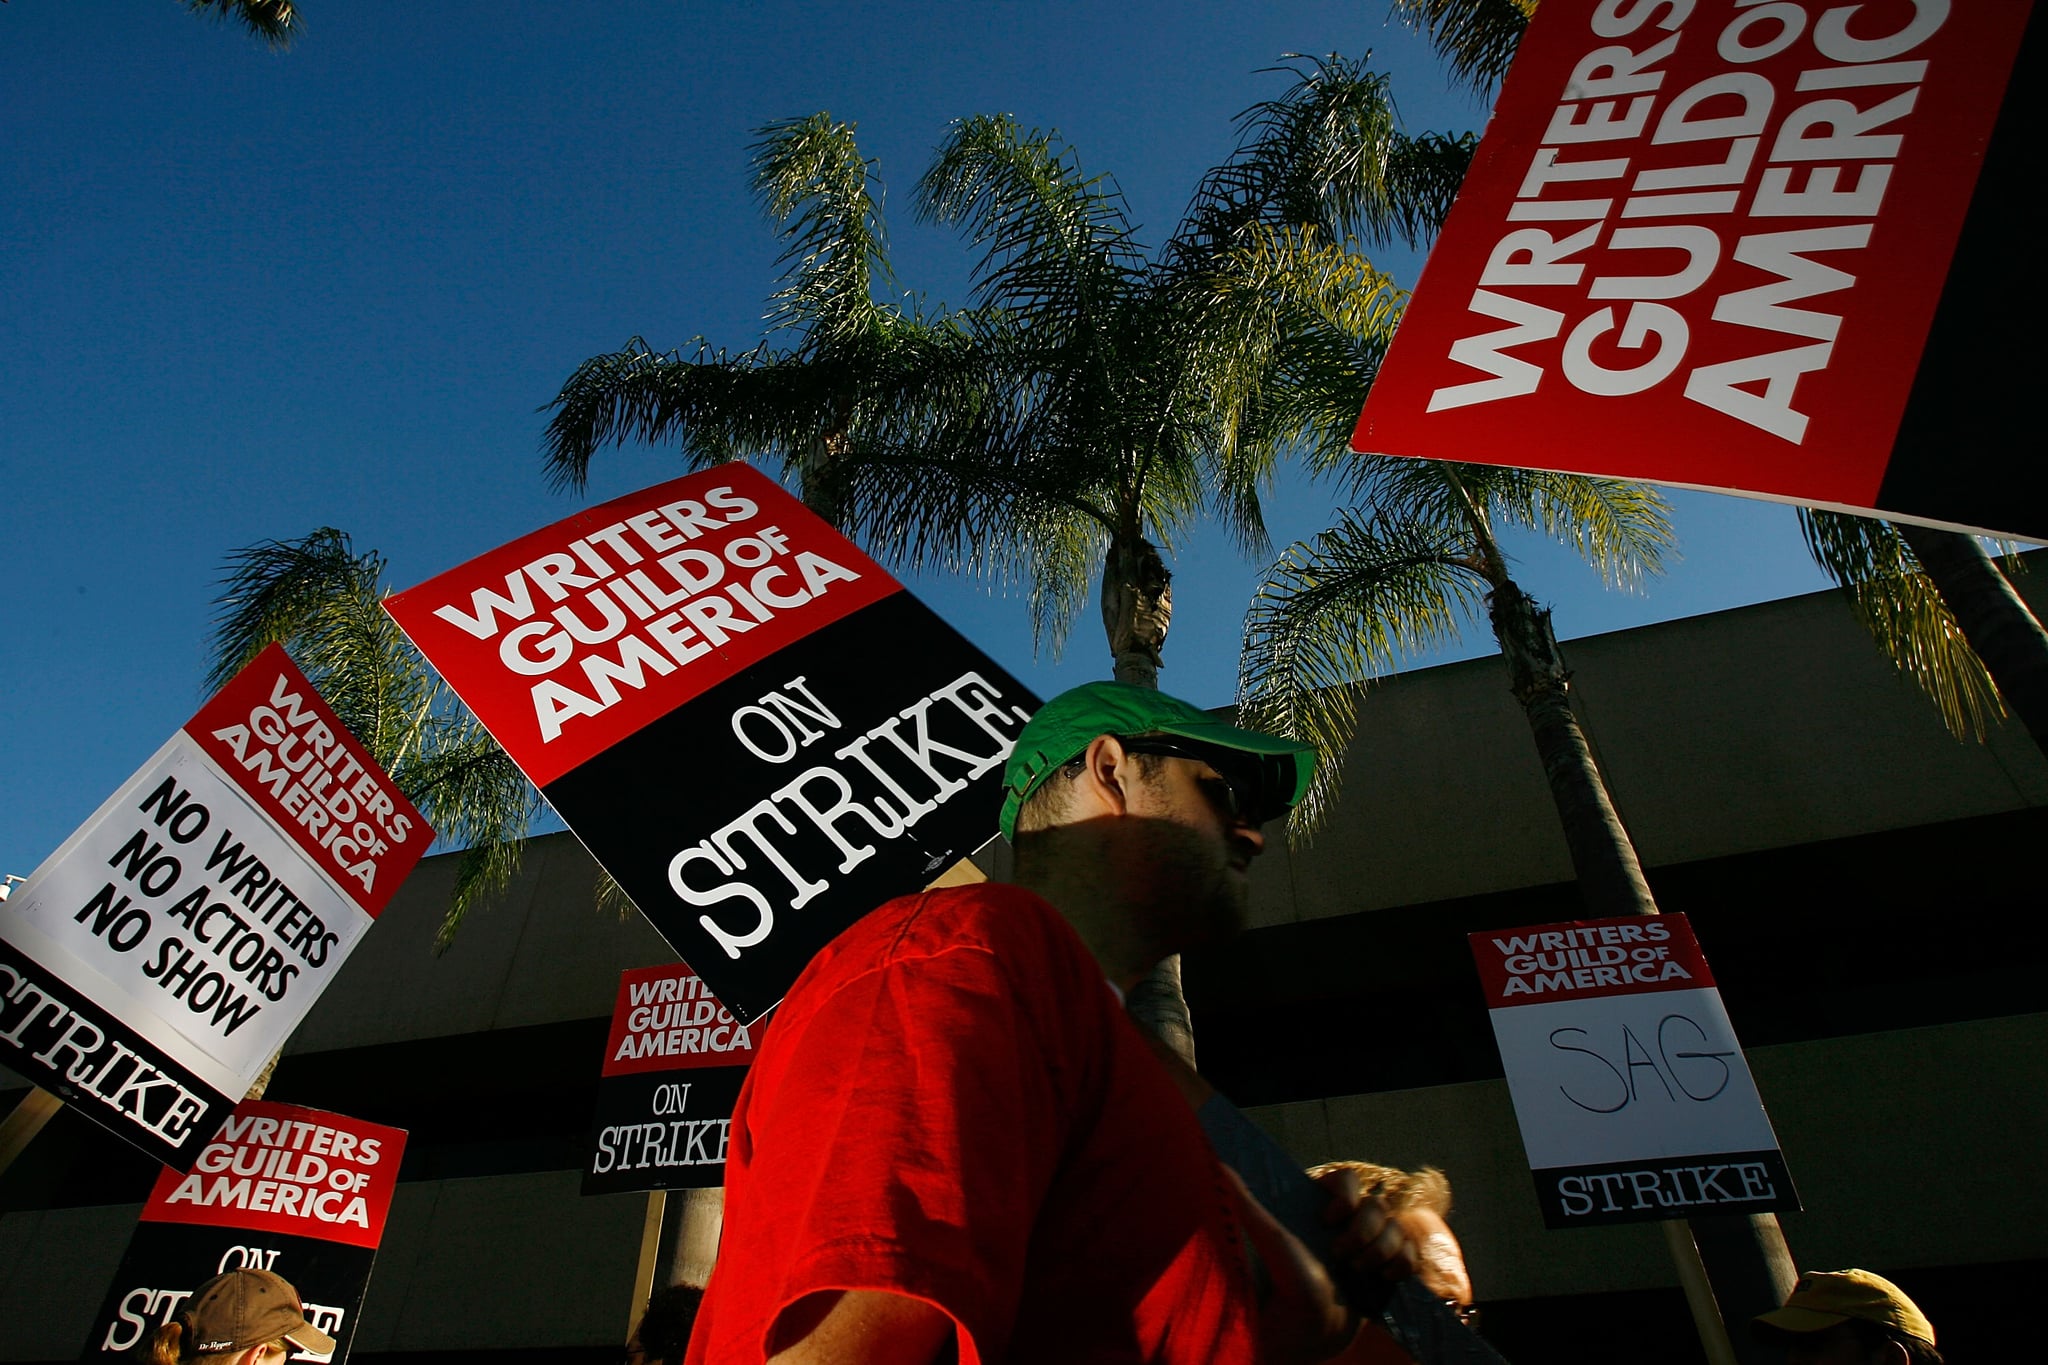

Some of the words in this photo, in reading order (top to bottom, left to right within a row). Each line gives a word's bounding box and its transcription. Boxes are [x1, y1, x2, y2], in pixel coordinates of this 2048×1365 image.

[1426, 0, 1697, 412] WRITERS
[1562, 72, 1775, 396] GUILD
[1717, 0, 1809, 63] O
[432, 486, 759, 641] WRITERS
[499, 549, 726, 675] GUILD
[724, 525, 791, 569] OF
[528, 551, 862, 744] AMERICA
[268, 672, 413, 844] WRITERS
[731, 675, 842, 764] ON
[212, 723, 378, 894] AMERICA
[248, 705, 361, 824] GUILD
[353, 821, 390, 856] OF
[668, 671, 1032, 960] STRIKE
[109, 829, 181, 898] NO
[167, 886, 298, 1002] ACTORS
[139, 776, 211, 844] NO
[208, 830, 338, 969] WRITERS
[75, 882, 151, 953] NO
[143, 938, 261, 1037] SHOW
[1492, 923, 1670, 955] WRITERS
[1502, 961, 1692, 997] AMERICA
[1504, 946, 1630, 975] GUILD
[1630, 947, 1670, 961] OF
[614, 1025, 752, 1061] AMERICA
[627, 1001, 717, 1032] GUILD
[717, 1008, 739, 1025] O
[652, 1083, 692, 1116] ON
[1550, 1015, 1736, 1113] SAG
[195, 1143, 328, 1185] GUILD
[328, 1168, 370, 1193] OF
[211, 1114, 382, 1166] WRITERS
[164, 1174, 369, 1229] AMERICA
[1557, 1161, 1777, 1216] STRIKE
[217, 1244, 282, 1275] ON
[101, 1287, 345, 1364] STE
